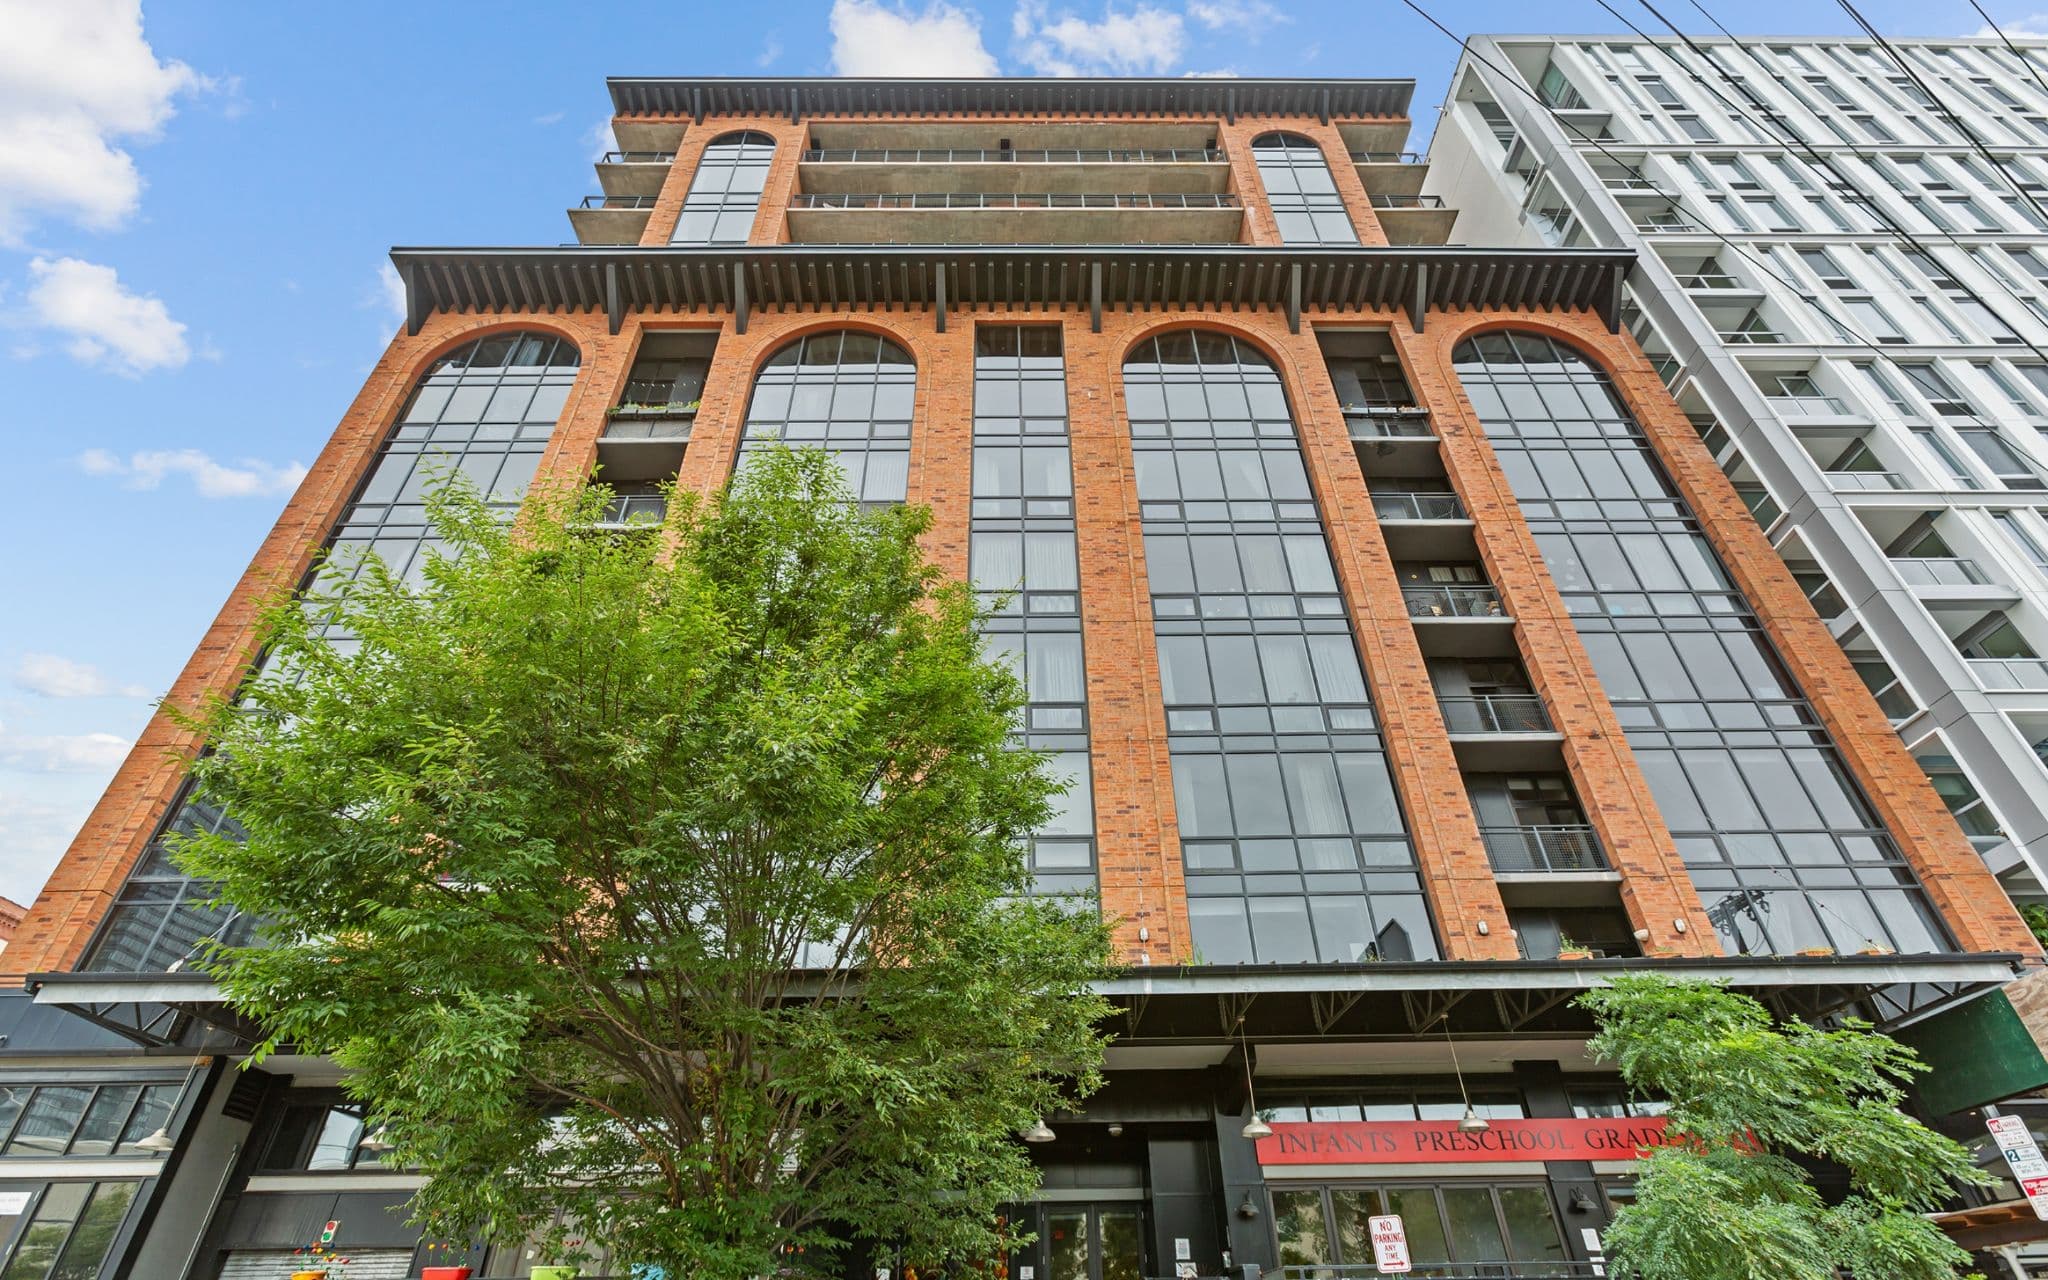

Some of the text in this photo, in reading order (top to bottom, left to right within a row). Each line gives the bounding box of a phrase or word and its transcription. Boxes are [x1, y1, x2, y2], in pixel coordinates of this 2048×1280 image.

[1278, 1130, 1398, 1153] INFANTS
[1414, 1127, 1575, 1151] PRESCHOOL
[2008, 1150, 2019, 1161] 2
[1380, 1221, 1392, 1231] NO
[1374, 1232, 1403, 1243] PARKING
[1385, 1252, 1399, 1260] TIME
